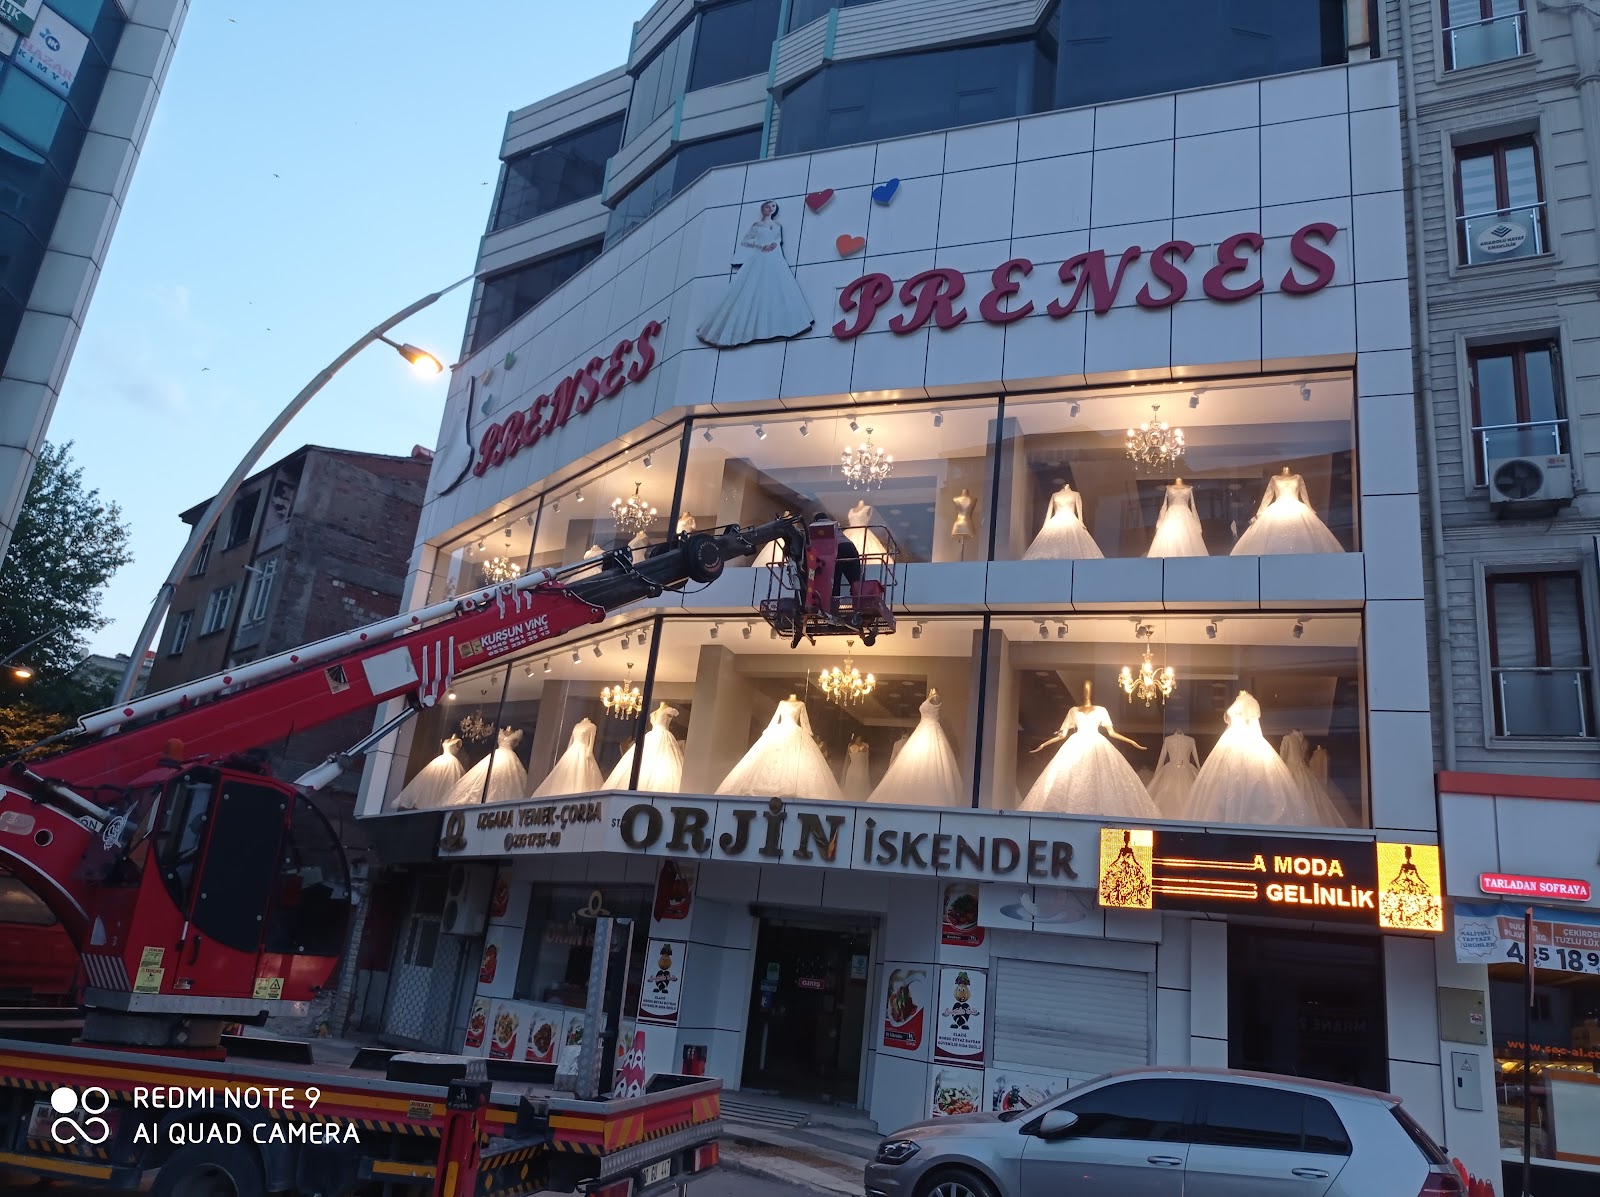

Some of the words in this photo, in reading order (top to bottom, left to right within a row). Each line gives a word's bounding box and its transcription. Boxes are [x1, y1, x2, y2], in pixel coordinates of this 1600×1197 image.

[1480, 238, 1507, 246] ANADOLU
[833, 222, 1339, 341] PRENSES
[473, 320, 662, 477] PRENSES
[481, 623, 523, 648] KURŞUN
[477, 810, 514, 830] IZGARA
[620, 796, 846, 863] ORJİN
[864, 816, 1079, 880] İSKENDER
[1274, 855, 1345, 878] MODA
[1265, 882, 1375, 909] GELİNLİK
[1483, 877, 1537, 891] TARLADAN
[1539, 882, 1588, 896] SOFRAYA
[1461, 929, 1491, 937] KALİTELİ
[1555, 935, 1582, 946] TUZLU
[1583, 938, 1600, 948] LÜX
